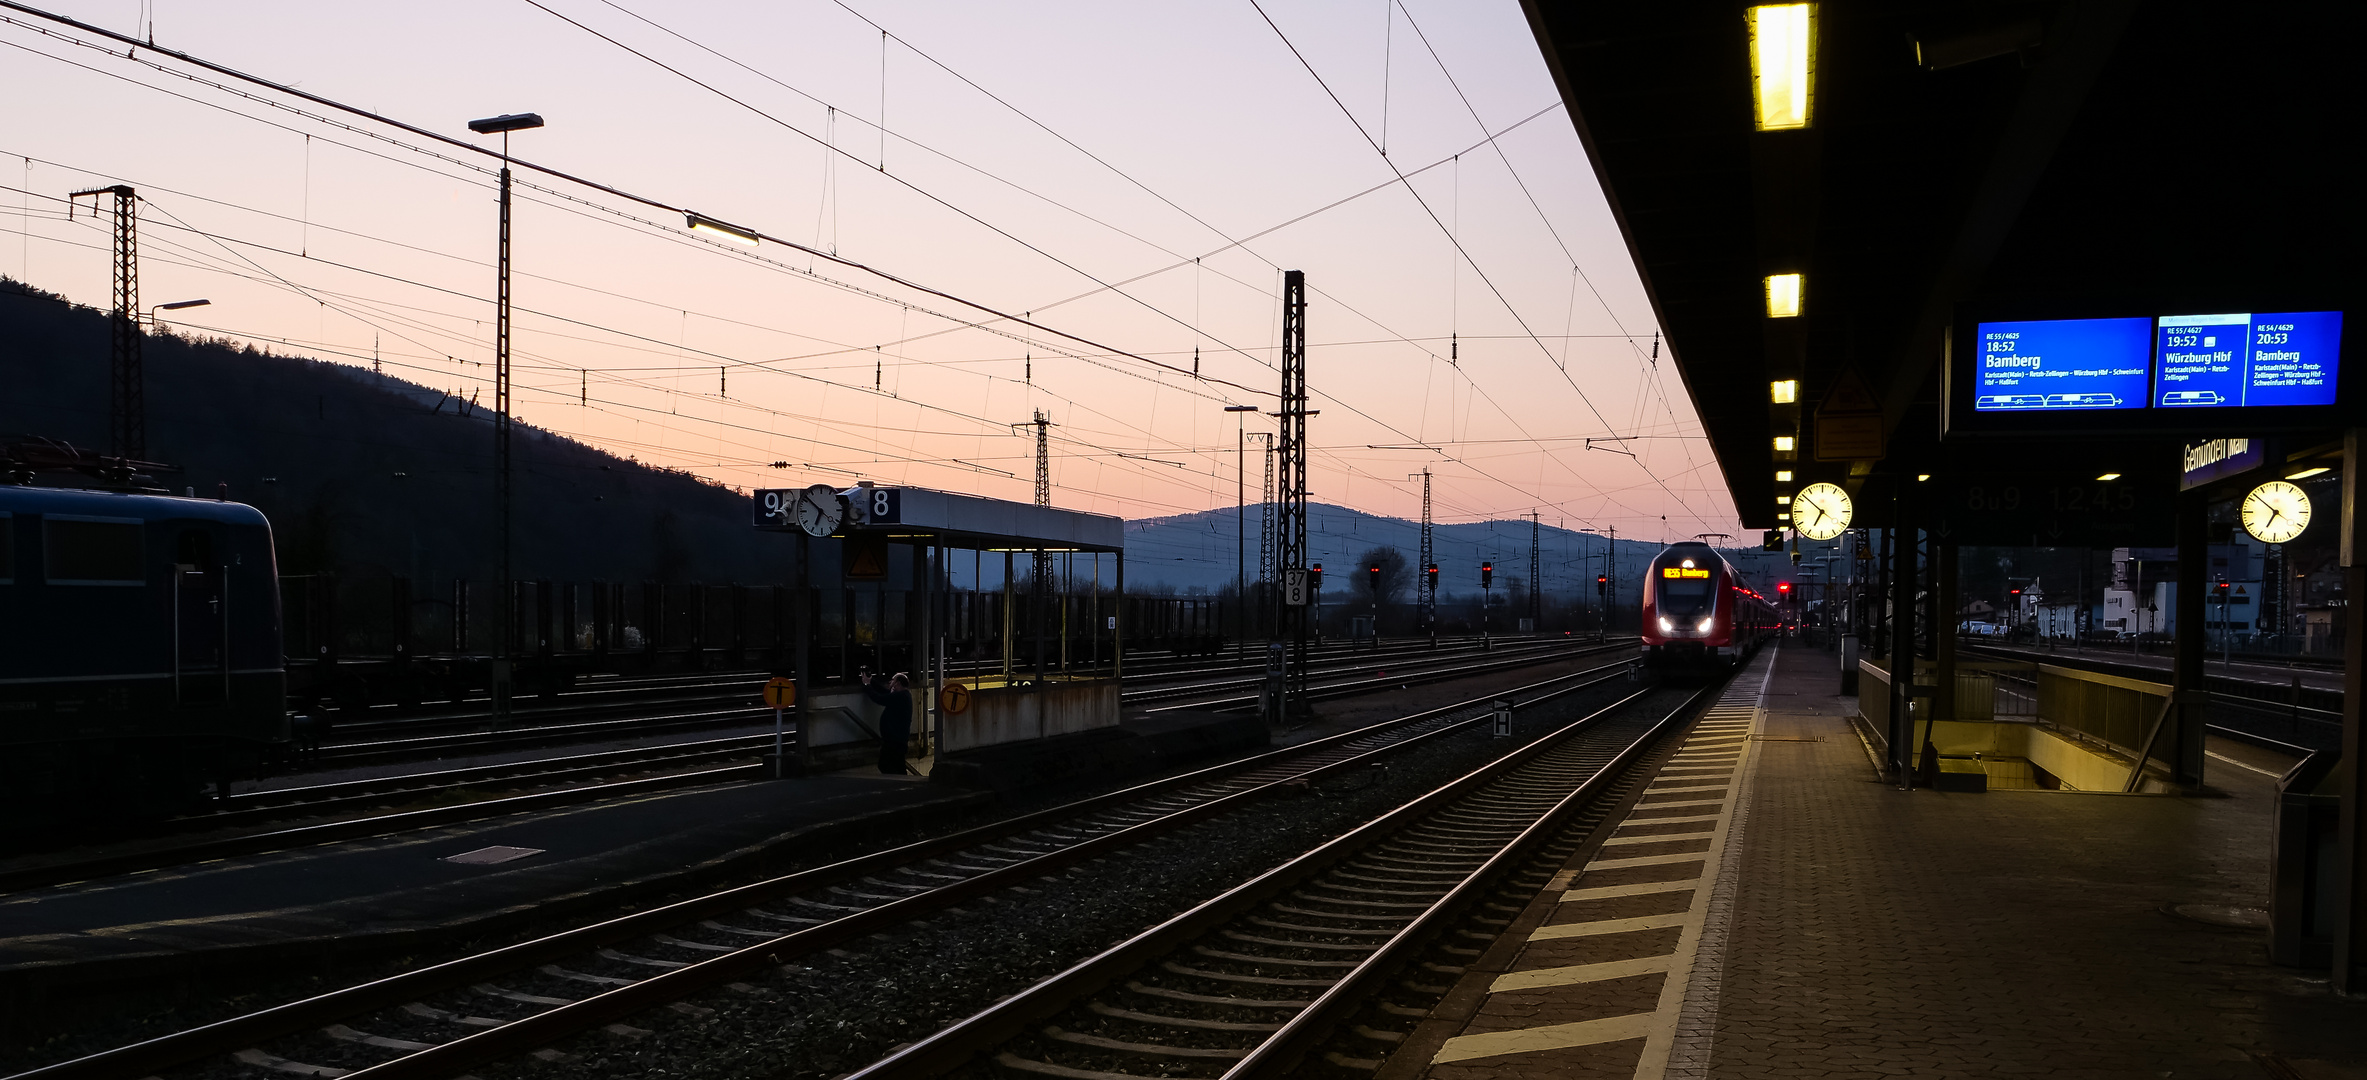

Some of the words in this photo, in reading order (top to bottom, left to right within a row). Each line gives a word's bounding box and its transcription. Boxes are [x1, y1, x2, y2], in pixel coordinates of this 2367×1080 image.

[2167, 336, 2197, 347] 19:52
[2257, 334, 2288, 344] 20:53
[1986, 341, 2014, 352] 18:52
[1986, 354, 2041, 369] Bamberg
[2166, 352, 2211, 364] Würzburg
[2213, 351, 2232, 362] Hbf
[2256, 350, 2300, 362] Bamberg
[2284, 370, 2310, 378] Würzburg
[2184, 438, 2226, 473] Gemünden
[764, 492, 779, 517] 9
[873, 490, 889, 516] 8
[1288, 572, 1305, 586] 37
[1292, 588, 1300, 602] 8
[1496, 713, 1509, 734] H
